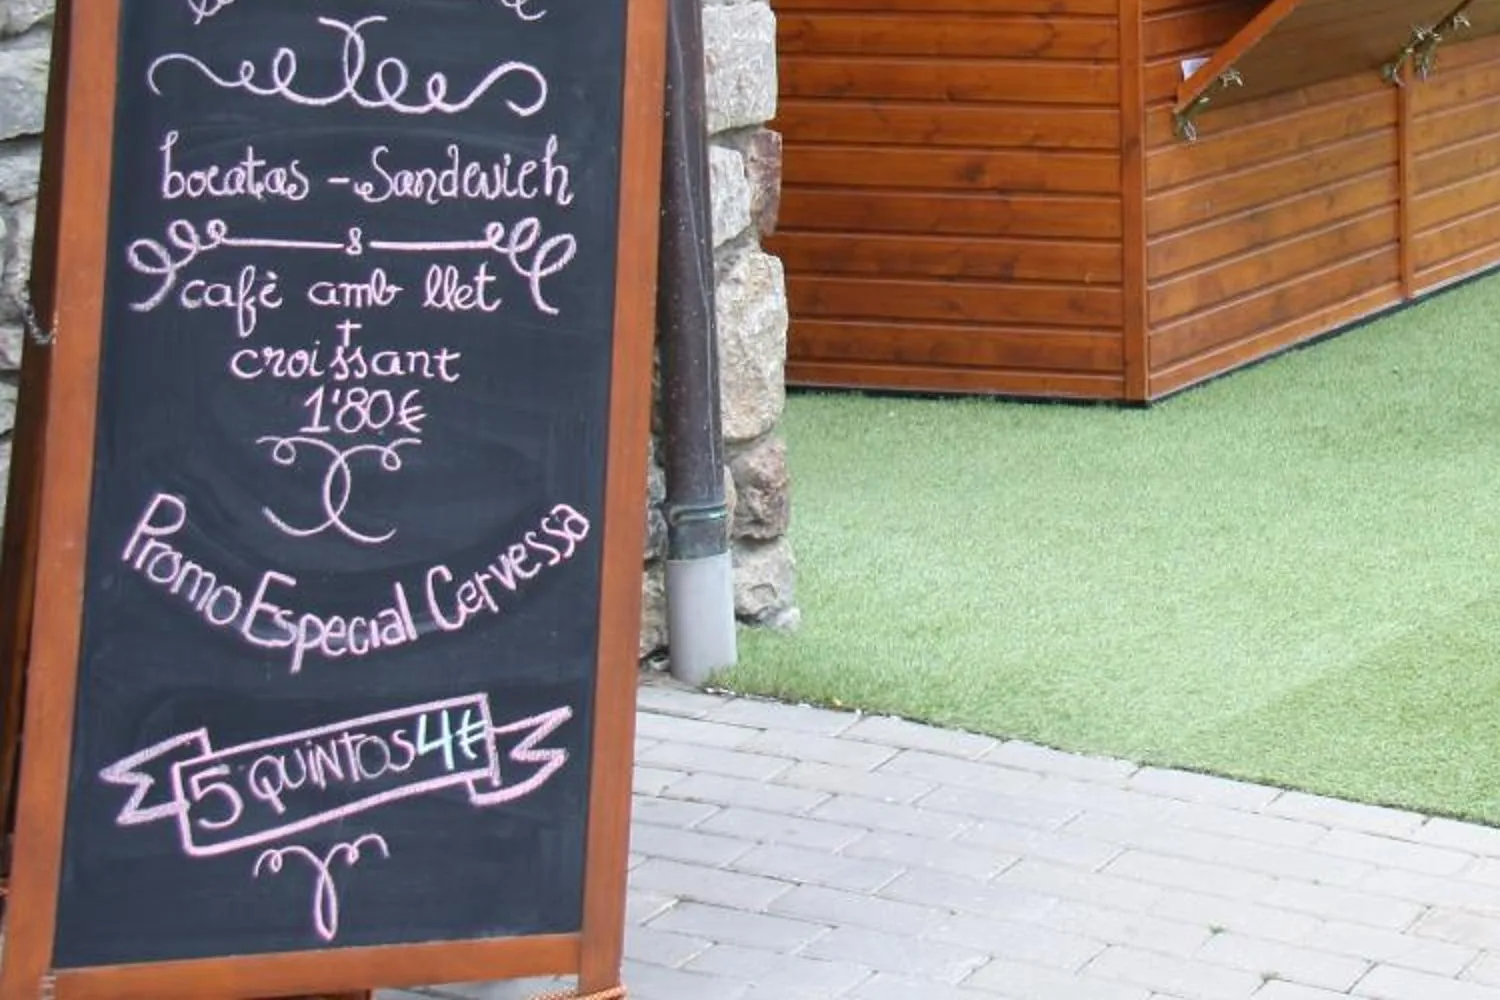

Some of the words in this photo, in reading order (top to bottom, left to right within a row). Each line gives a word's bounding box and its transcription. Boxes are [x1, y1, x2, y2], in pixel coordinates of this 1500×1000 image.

[160, 130, 309, 200] bocatas
[307, 267, 404, 308] amb
[423, 261, 502, 312] llet
[230, 340, 461, 382] croissant
[122, 492, 243, 626] Promo
[241, 570, 418, 673] Especial
[427, 503, 591, 631] Cervessa
[190, 763, 244, 829] 5
[415, 709, 490, 771] 4€
